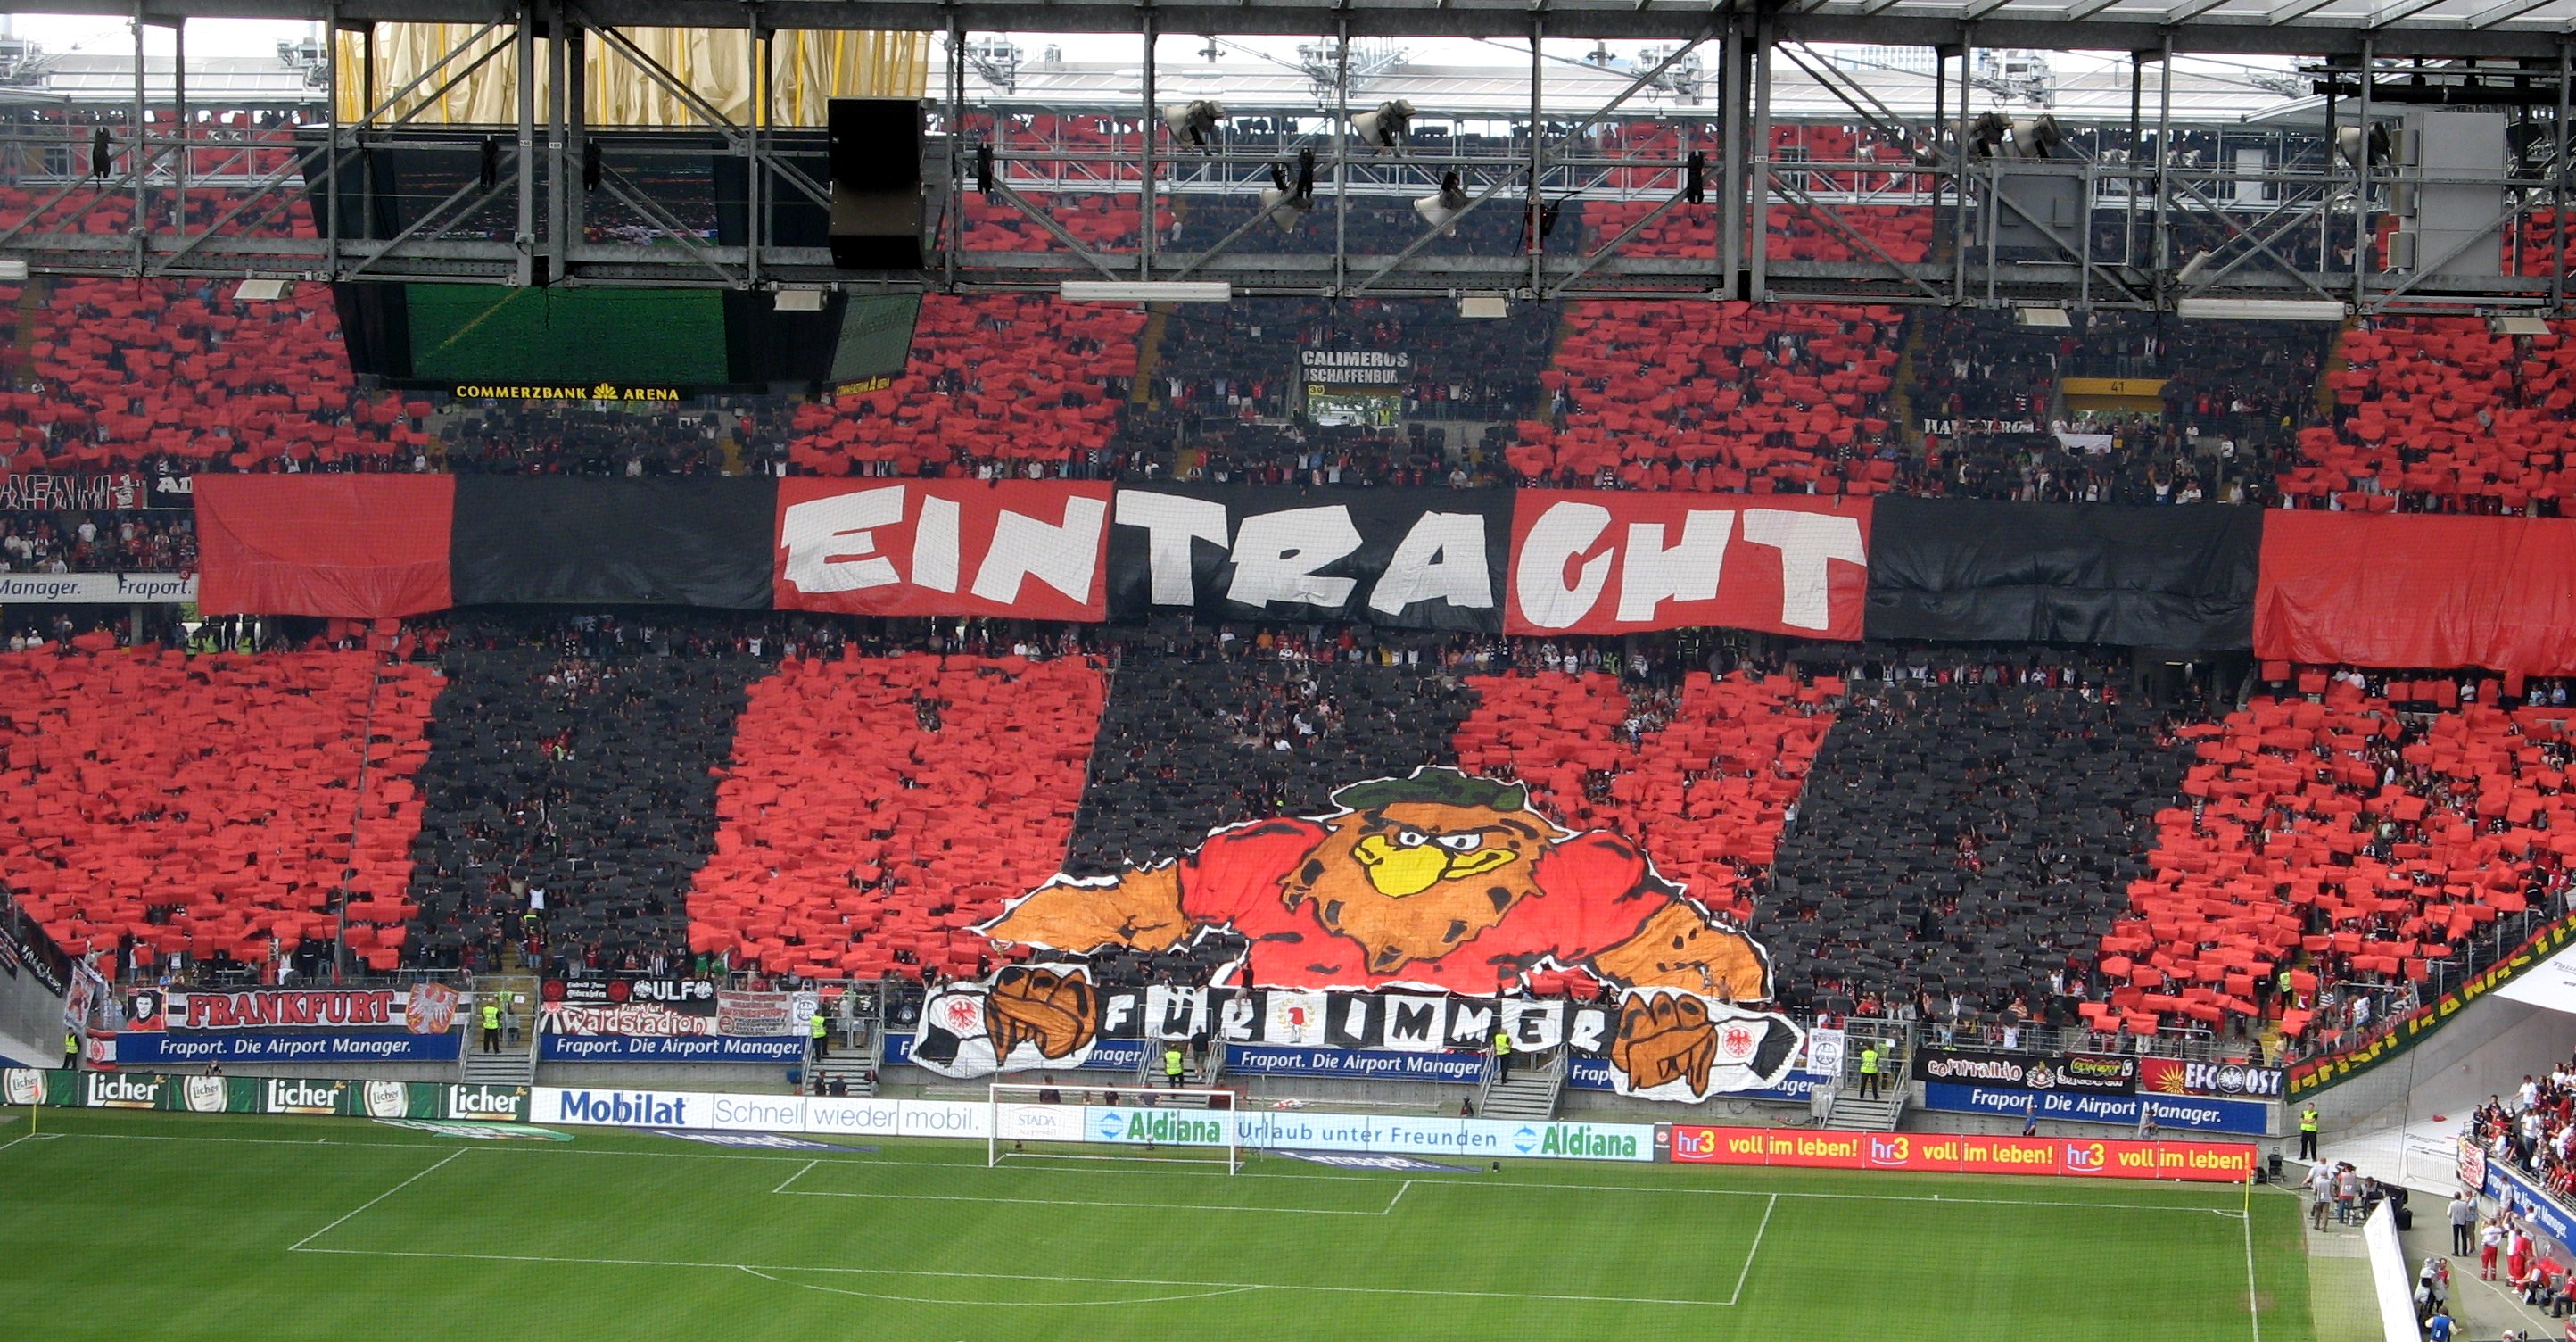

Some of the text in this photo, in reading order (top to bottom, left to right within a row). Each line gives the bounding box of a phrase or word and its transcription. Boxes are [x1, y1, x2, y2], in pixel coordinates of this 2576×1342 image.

[1302, 351, 1408, 367] CALIMEROS
[456, 386, 680, 402] COMMERZBANK ARENA
[2110, 381, 2125, 393] 41
[780, 485, 1867, 630] EINTRACHT
[118, 580, 192, 600] Fraport.
[653, 980, 695, 1001] ULF
[186, 990, 395, 1027] FRANKFURT
[561, 1008, 706, 1035] Waldstadion
[1104, 986, 1604, 1051] FÜR IMMER
[160, 1038, 410, 1057] Fraport. Die Airport Manager.
[557, 1038, 802, 1058] Fraport. Die Airport Manager.
[1241, 1050, 1306, 1070] Fraport.
[1313, 1052, 1338, 1067] Die
[1343, 1053, 1403, 1074] Airport
[87, 1073, 159, 1106] Licher
[193, 1085, 219, 1098] Licher
[2184, 1063, 2282, 1095] EFC OST
[268, 1078, 340, 1113] Licher
[373, 1089, 399, 1105] Licher
[448, 1084, 521, 1119] Licher
[1971, 1089, 2222, 1125] Fraport. Die Airport Manager.
[560, 1091, 979, 1131] Mobilat Schnell wieder mobil.
[1018, 1114, 1056, 1126] STADA
[1127, 1112, 1497, 1147] Aldiana Urlaub unter Freunden
[1542, 1126, 1637, 1157] Aldiana
[1678, 1130, 1858, 1157] hr3 voll im leben!
[1871, 1136, 2053, 1165] hr3 voll im leben!
[2067, 1143, 2250, 1171] hr3 voll im leben!
